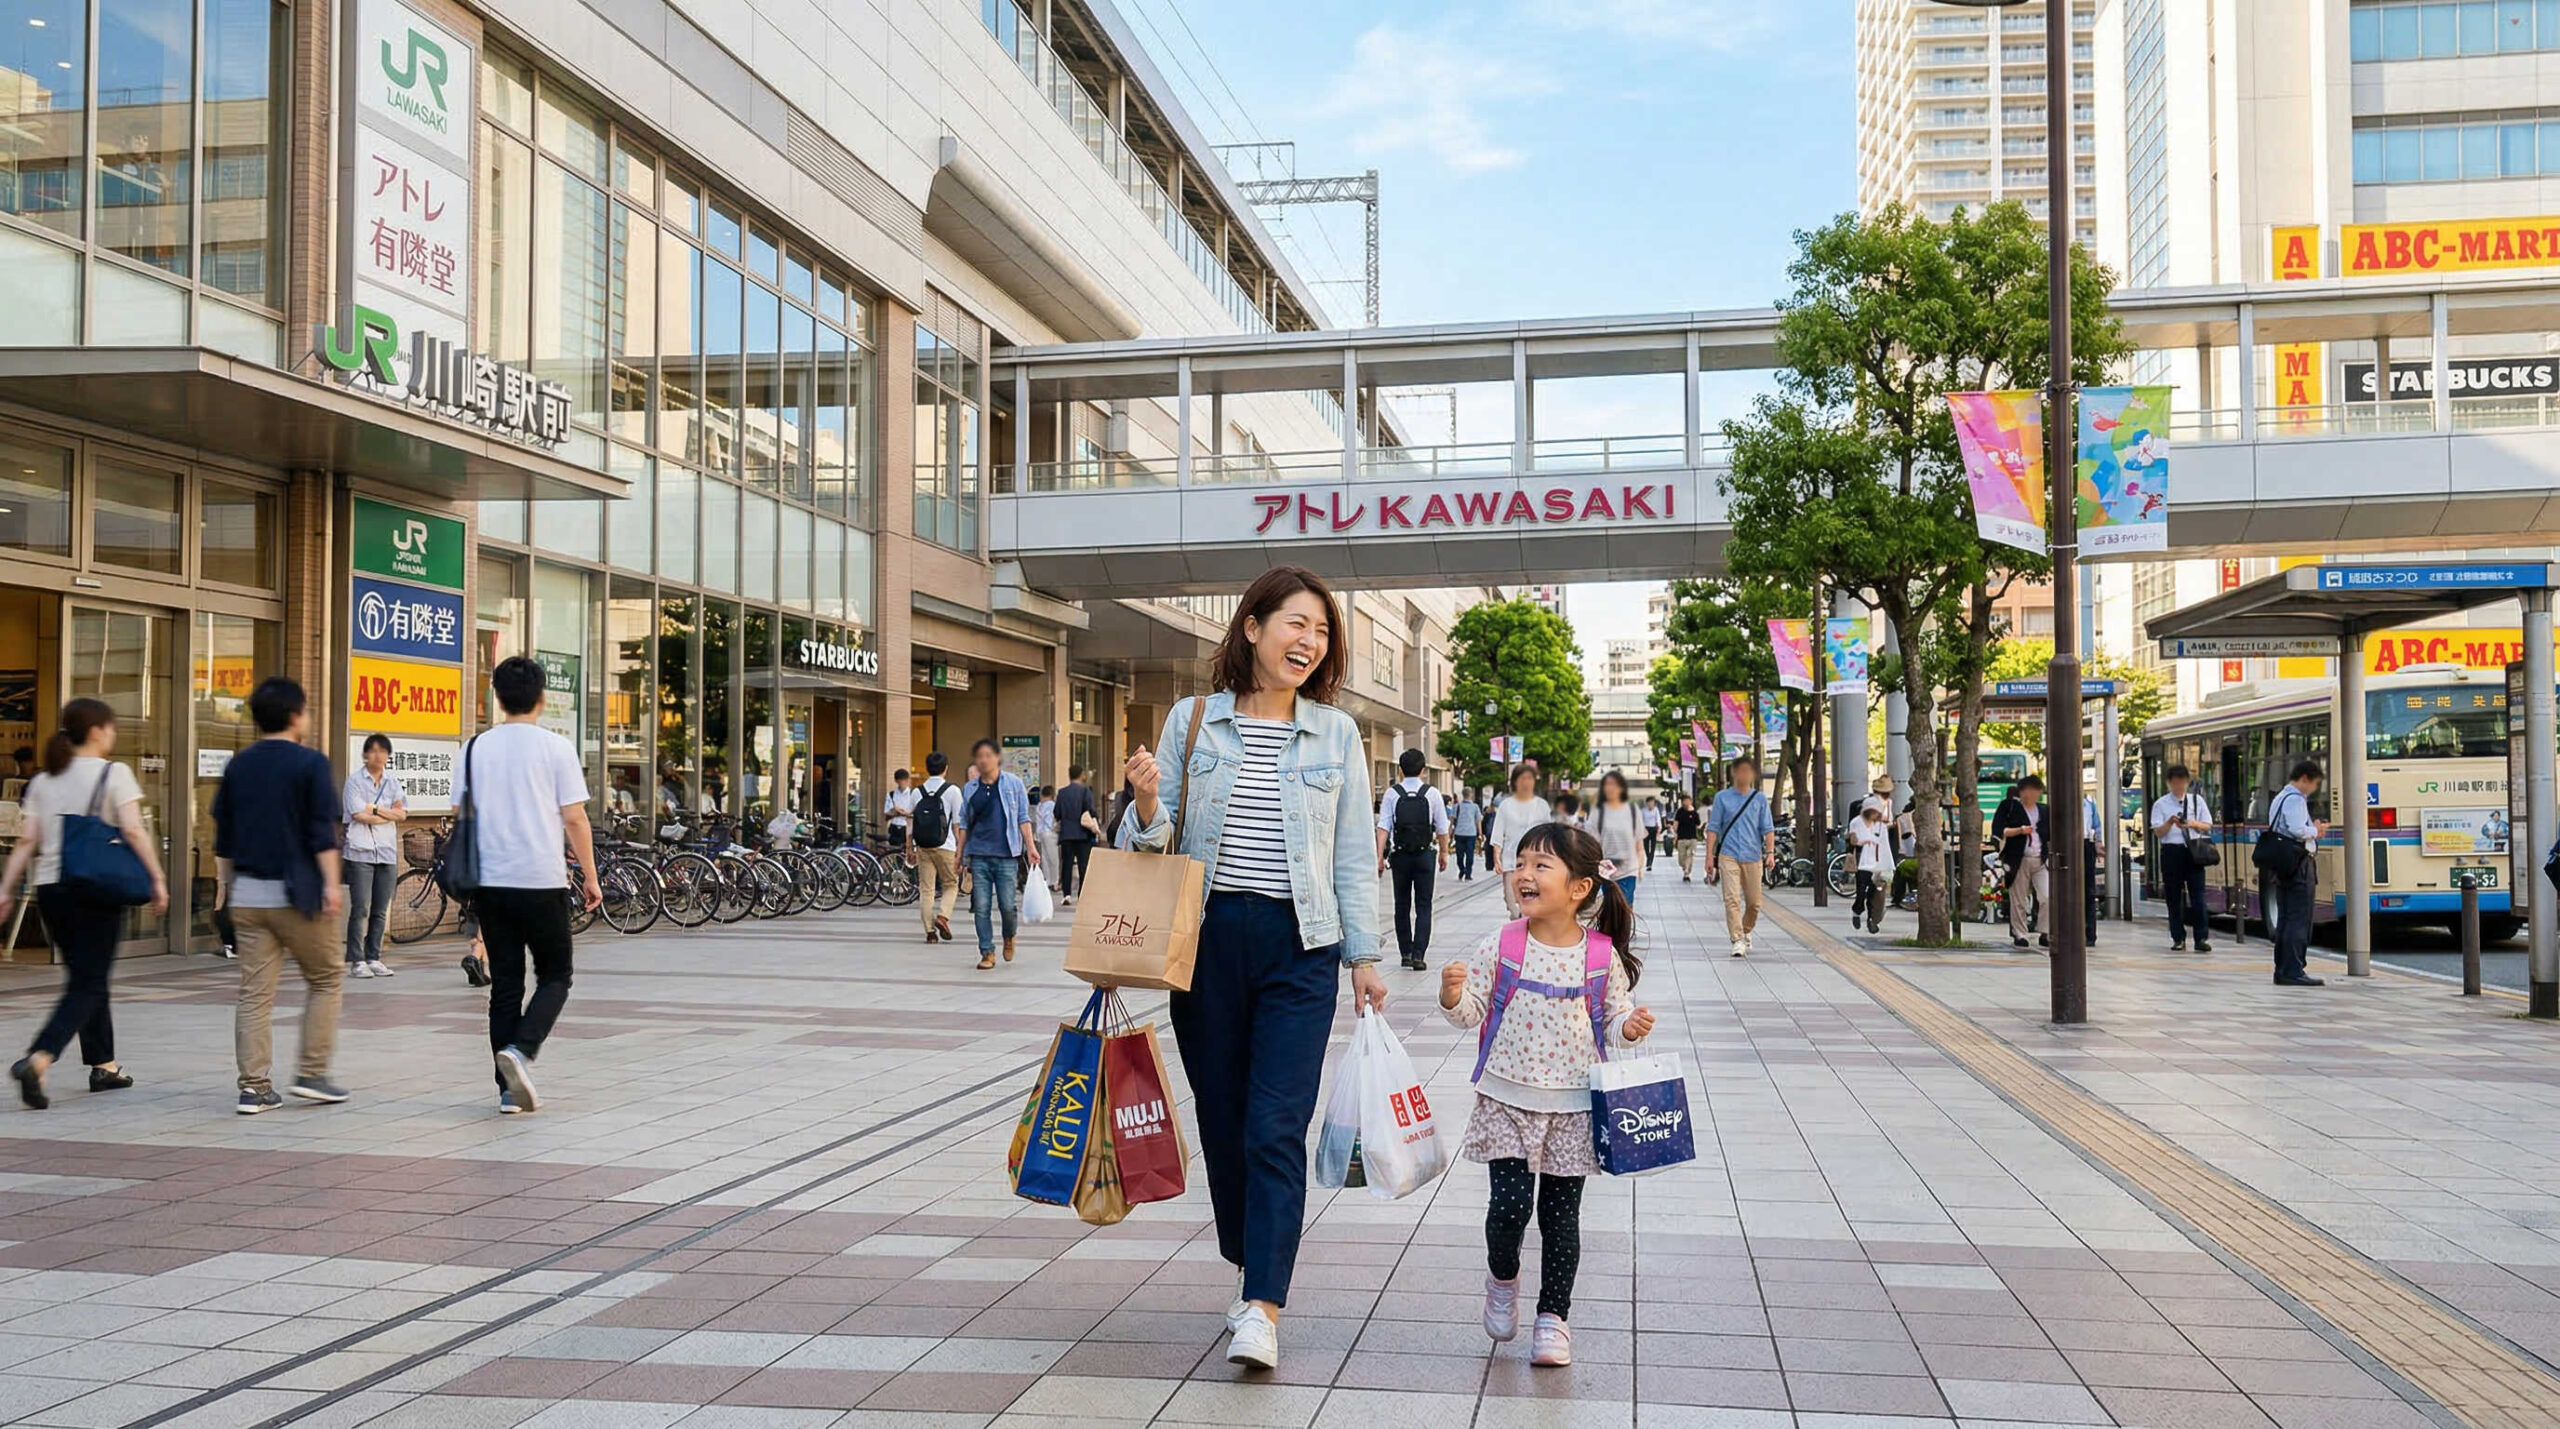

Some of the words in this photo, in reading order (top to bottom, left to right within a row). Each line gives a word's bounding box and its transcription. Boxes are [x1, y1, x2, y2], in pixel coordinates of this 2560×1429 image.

[381, 28, 448, 112] JR
[371, 153, 446, 222] アトレ
[369, 216, 456, 297] 有隣堂
[2352, 229, 2560, 270] ABC-MART
[326, 303, 400, 385] JR
[408, 330, 573, 444] 川崎駅前
[1254, 491, 1366, 533] アトレ
[1379, 484, 1675, 529] KAWASAKI
[393, 519, 428, 555] JR
[388, 599, 456, 646] 有隣堂
[800, 638, 878, 676] STARBUCKS
[2374, 637, 2524, 673] ABC-MA
[355, 675, 457, 715] ABC-MART
[2417, 781, 2439, 793] JR
[1095, 914, 1148, 936] アトレ
[1046, 1071, 1090, 1160] KALDI
[1115, 1099, 1166, 1130] MUJI
